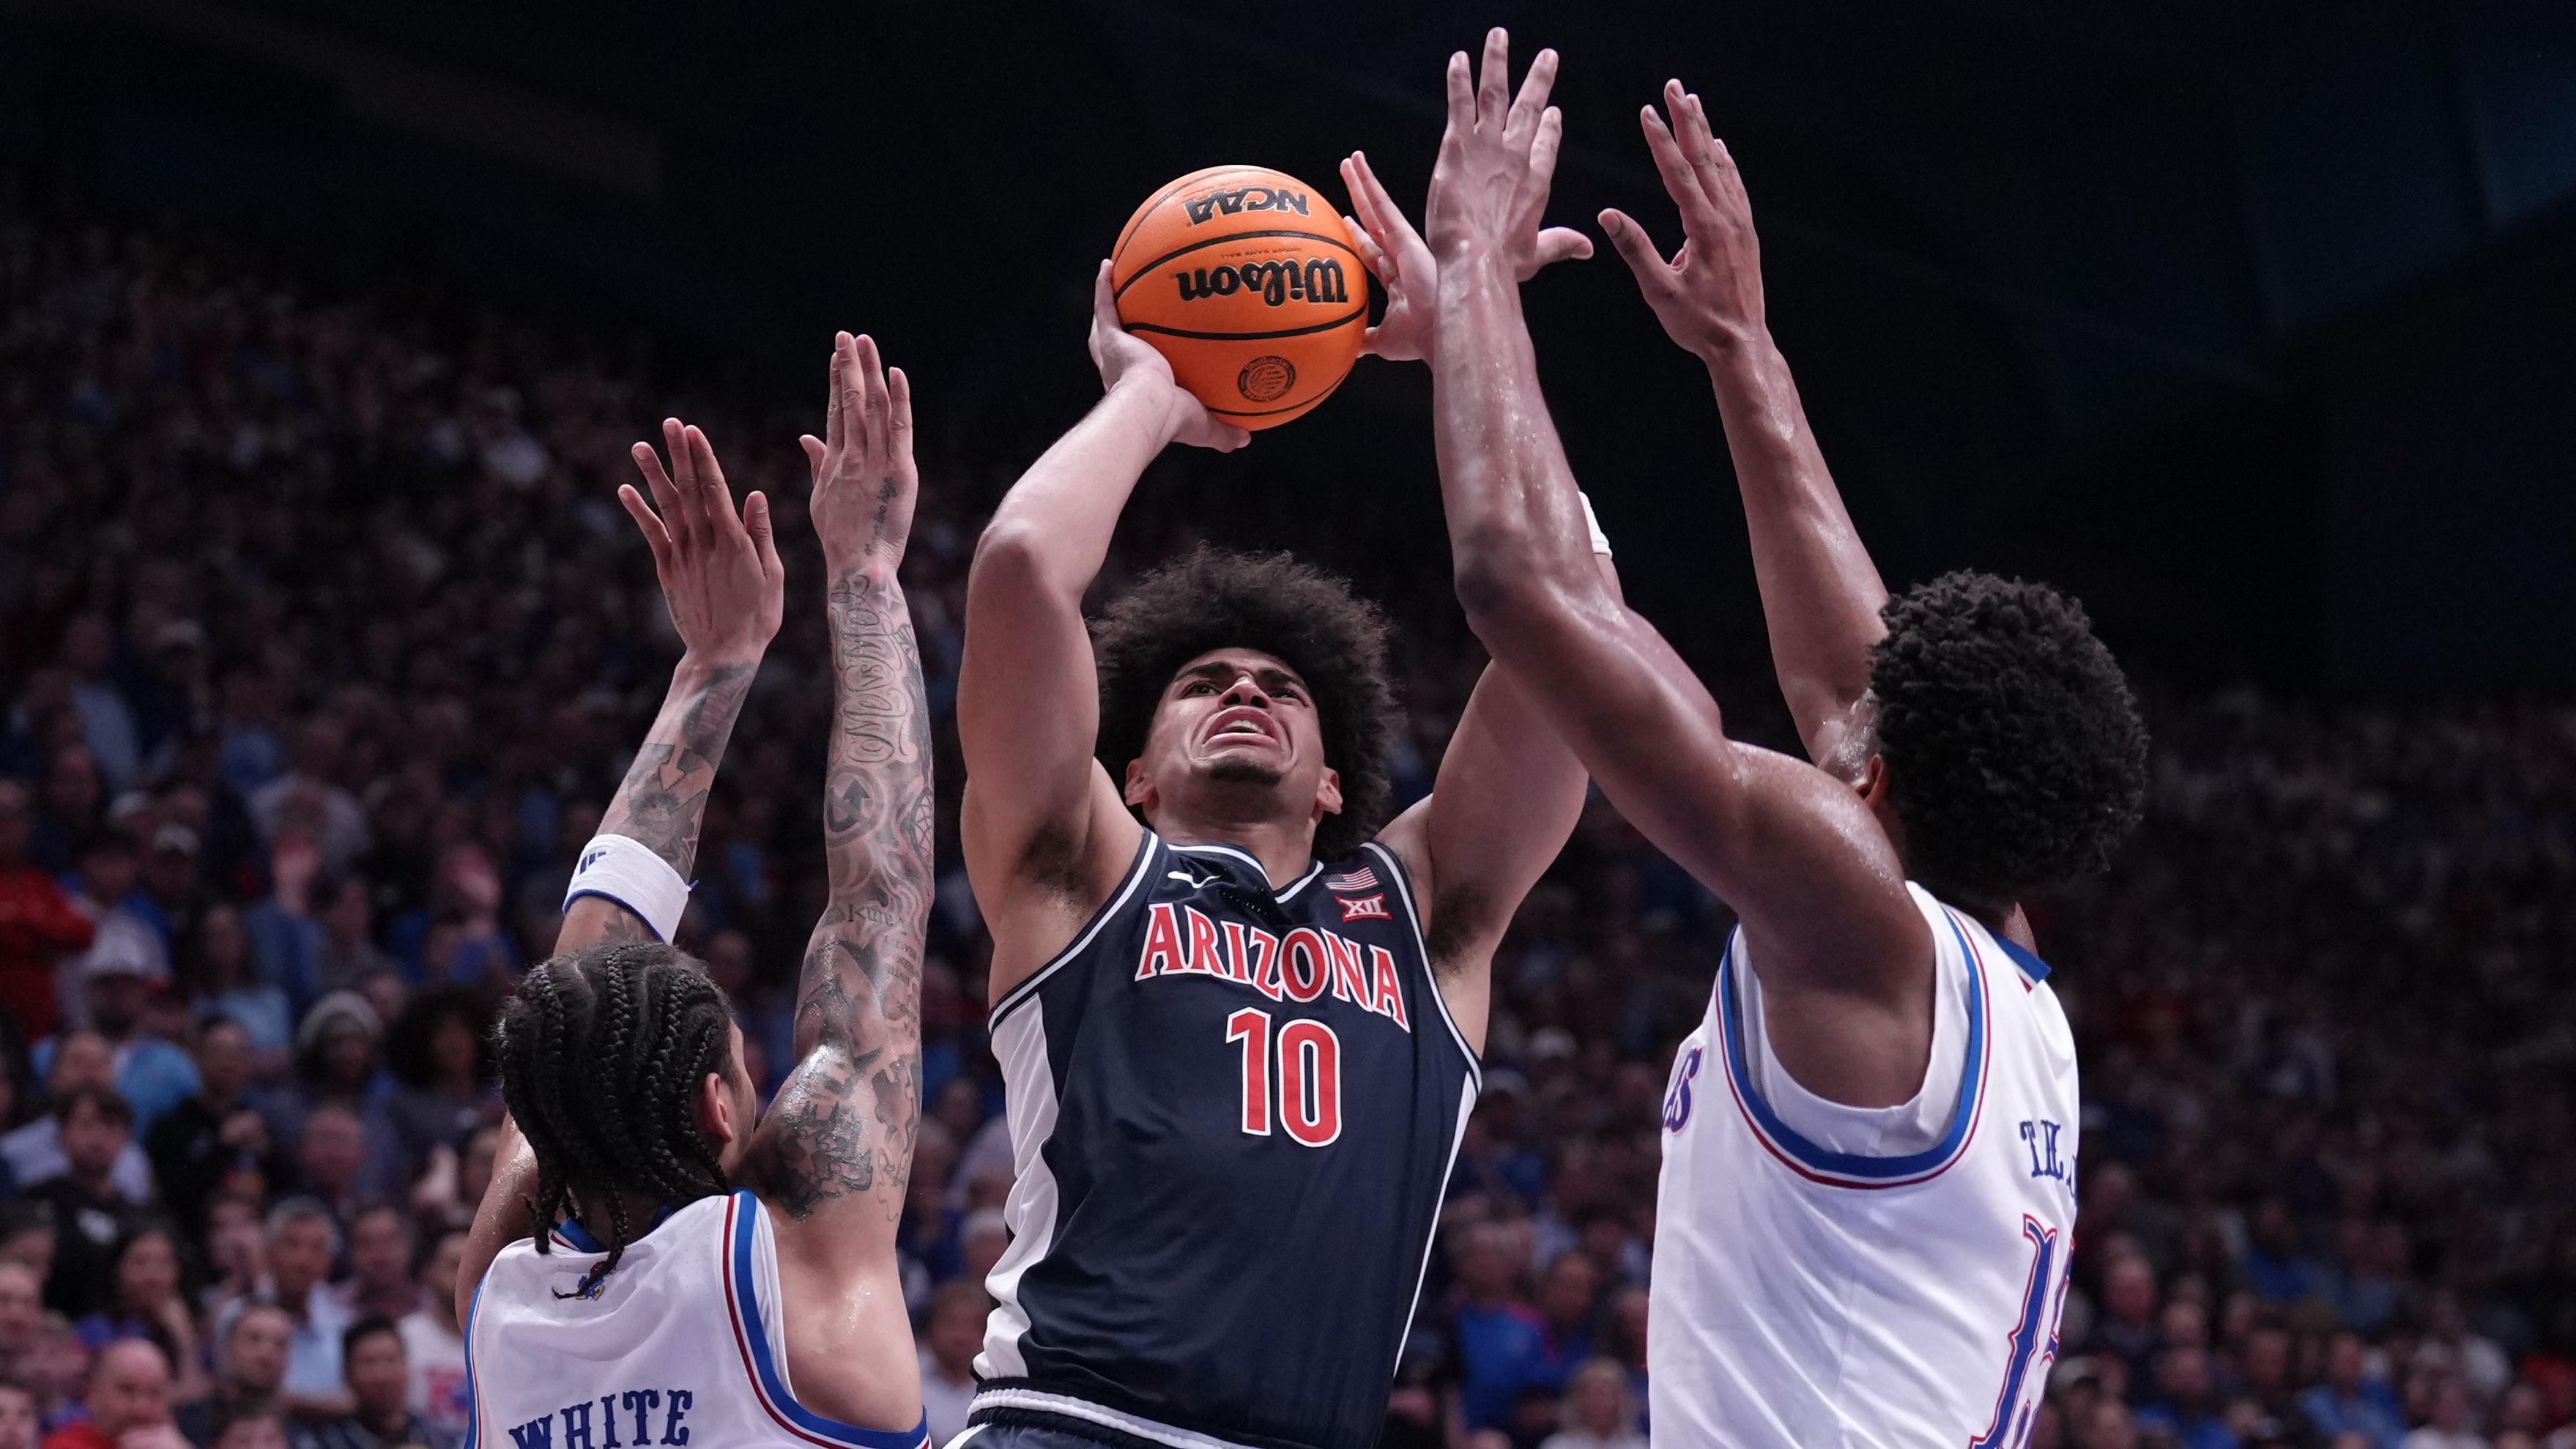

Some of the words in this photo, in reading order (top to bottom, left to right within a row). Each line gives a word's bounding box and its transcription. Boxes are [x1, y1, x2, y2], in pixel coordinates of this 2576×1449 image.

[1184, 187, 1311, 226] NCAA
[1174, 258, 1349, 308] Wilson
[1337, 894, 1392, 921] XII
[1135, 902, 1411, 1034] ARIZONA
[1225, 1007, 1343, 1148] 10
[508, 1388, 694, 1449] WHITE
